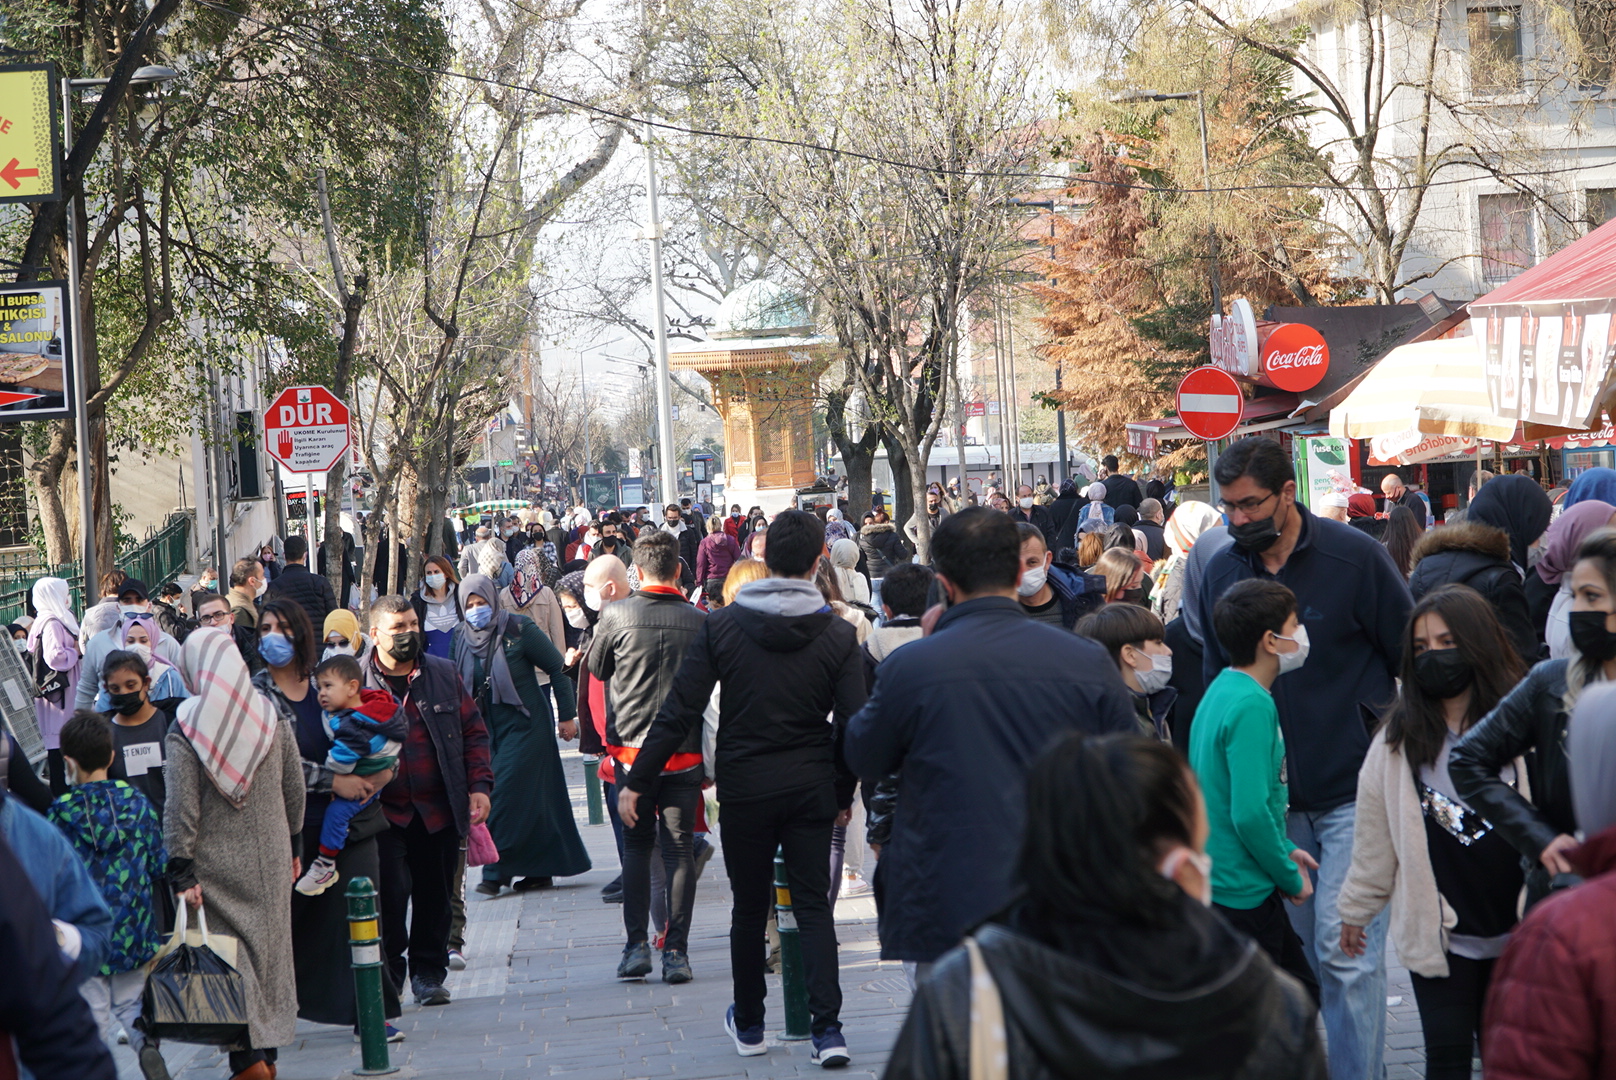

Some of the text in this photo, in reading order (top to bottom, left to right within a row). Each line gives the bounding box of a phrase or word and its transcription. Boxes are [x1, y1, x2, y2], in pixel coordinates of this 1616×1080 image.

[7, 295, 46, 306] BURSA
[3, 322, 12, 332] &
[0, 330, 53, 344] SALONU
[1266, 344, 1325, 371] Coca-Cola
[279, 402, 334, 427] DUR
[41, 681, 61, 695] FILA
[131, 746, 152, 757] ENJOY
